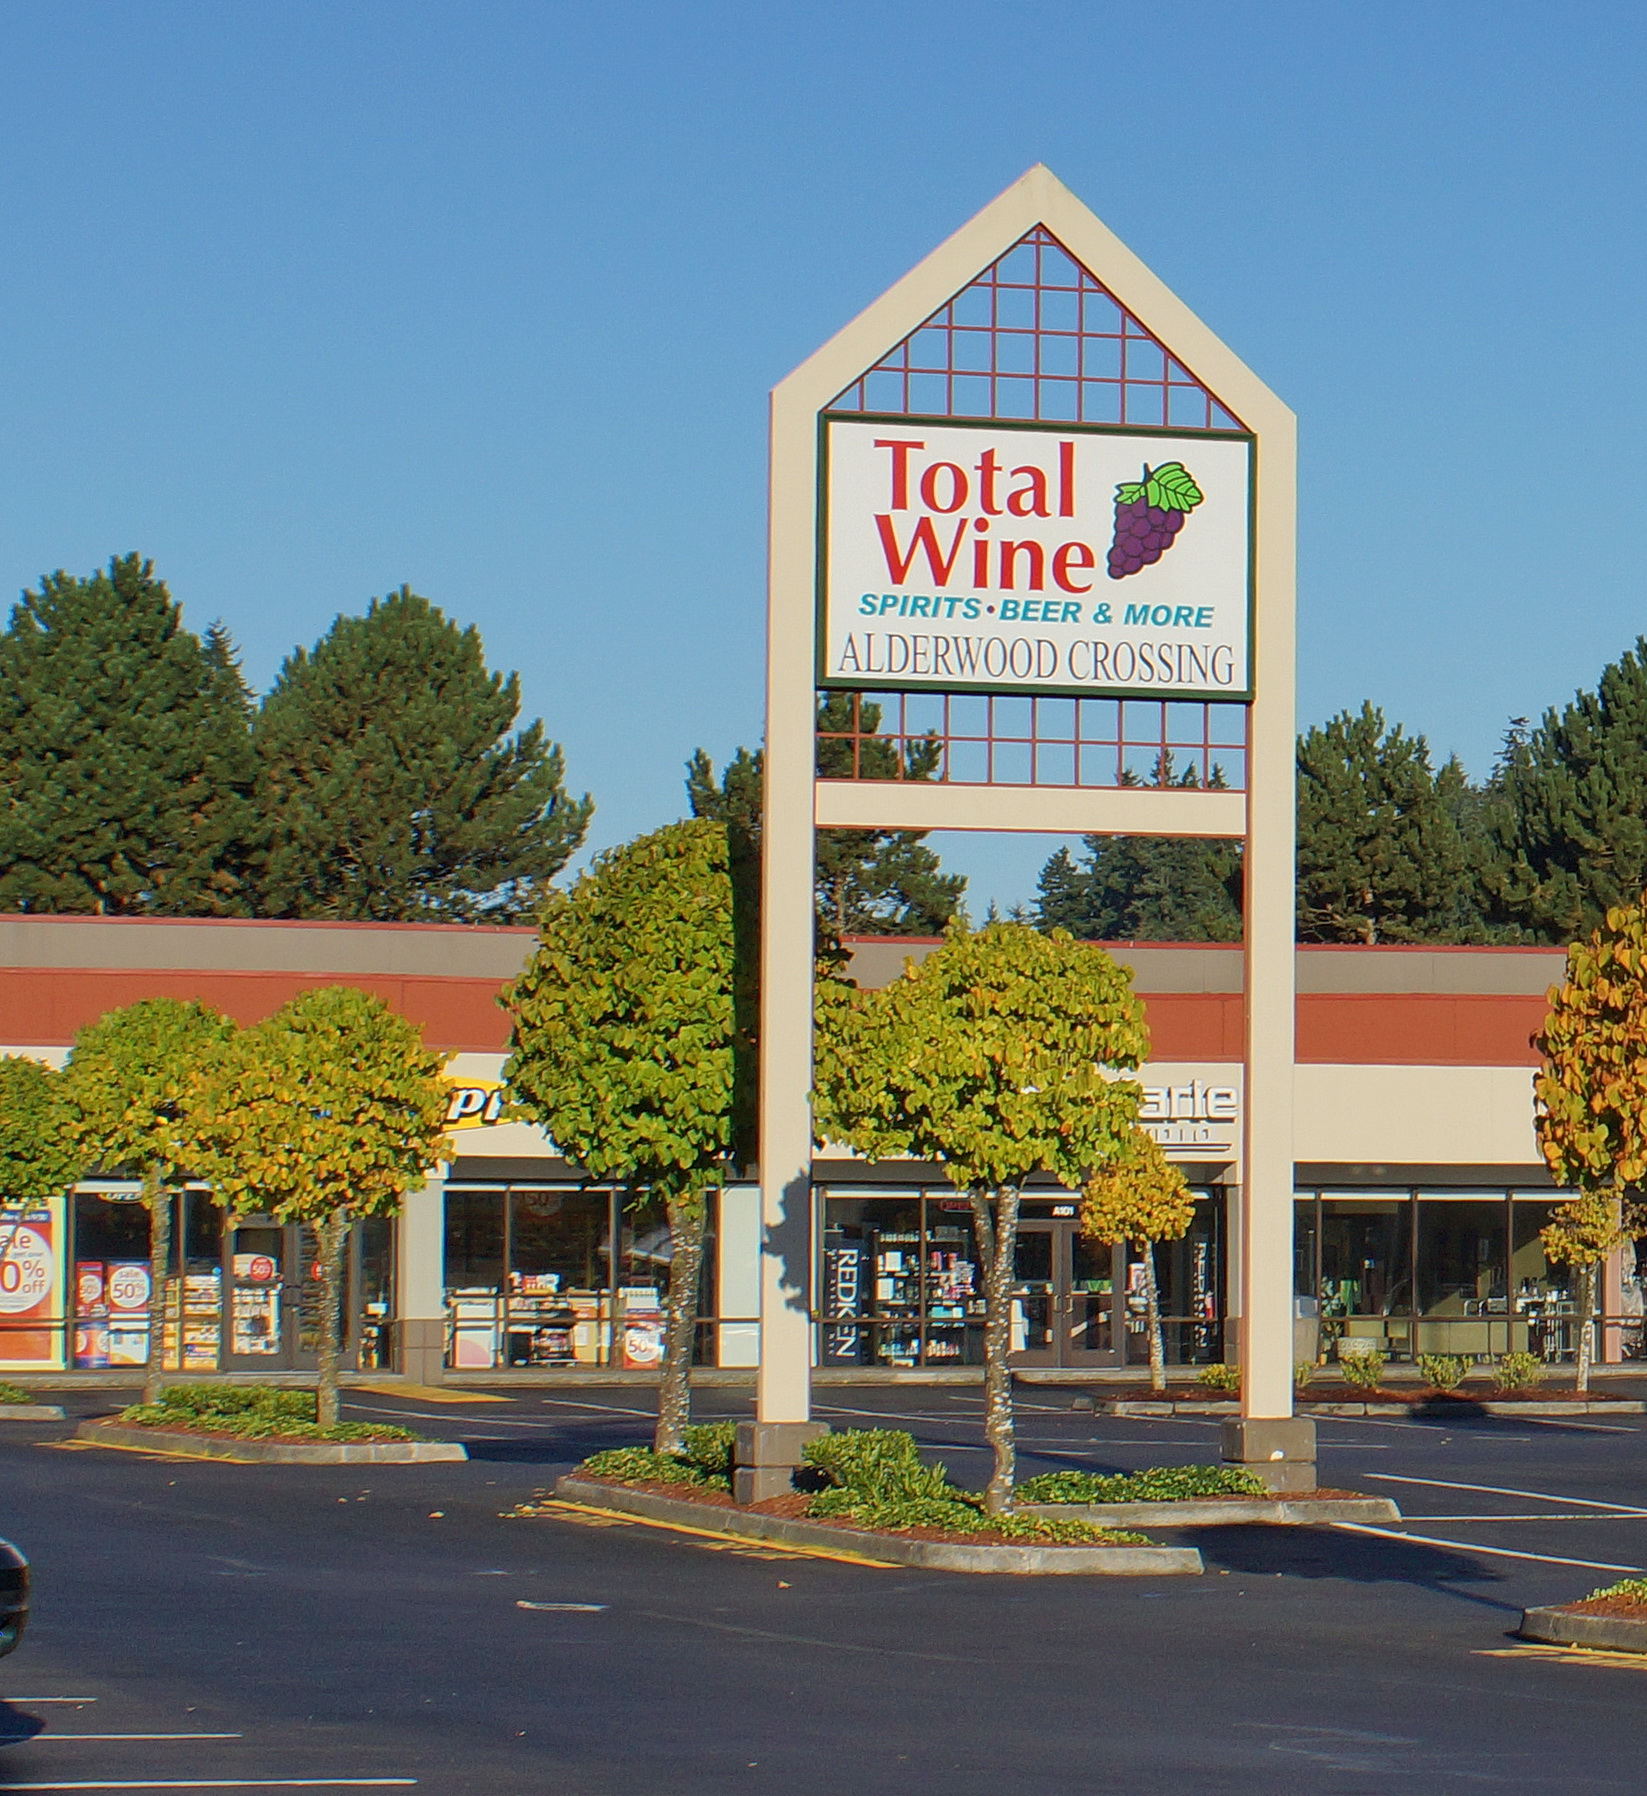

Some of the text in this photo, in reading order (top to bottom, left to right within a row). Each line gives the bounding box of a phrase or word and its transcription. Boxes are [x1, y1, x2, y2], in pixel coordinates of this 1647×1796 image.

[873, 438, 1075, 519] Total
[873, 513, 1095, 594] Wine
[1092, 602, 1114, 626] &
[1123, 602, 1216, 629] MORE
[838, 631, 1236, 687] ALDERWOOD CROSSING
[22, 1281, 46, 1294] off
[836, 1248, 860, 1358] REDKEN
